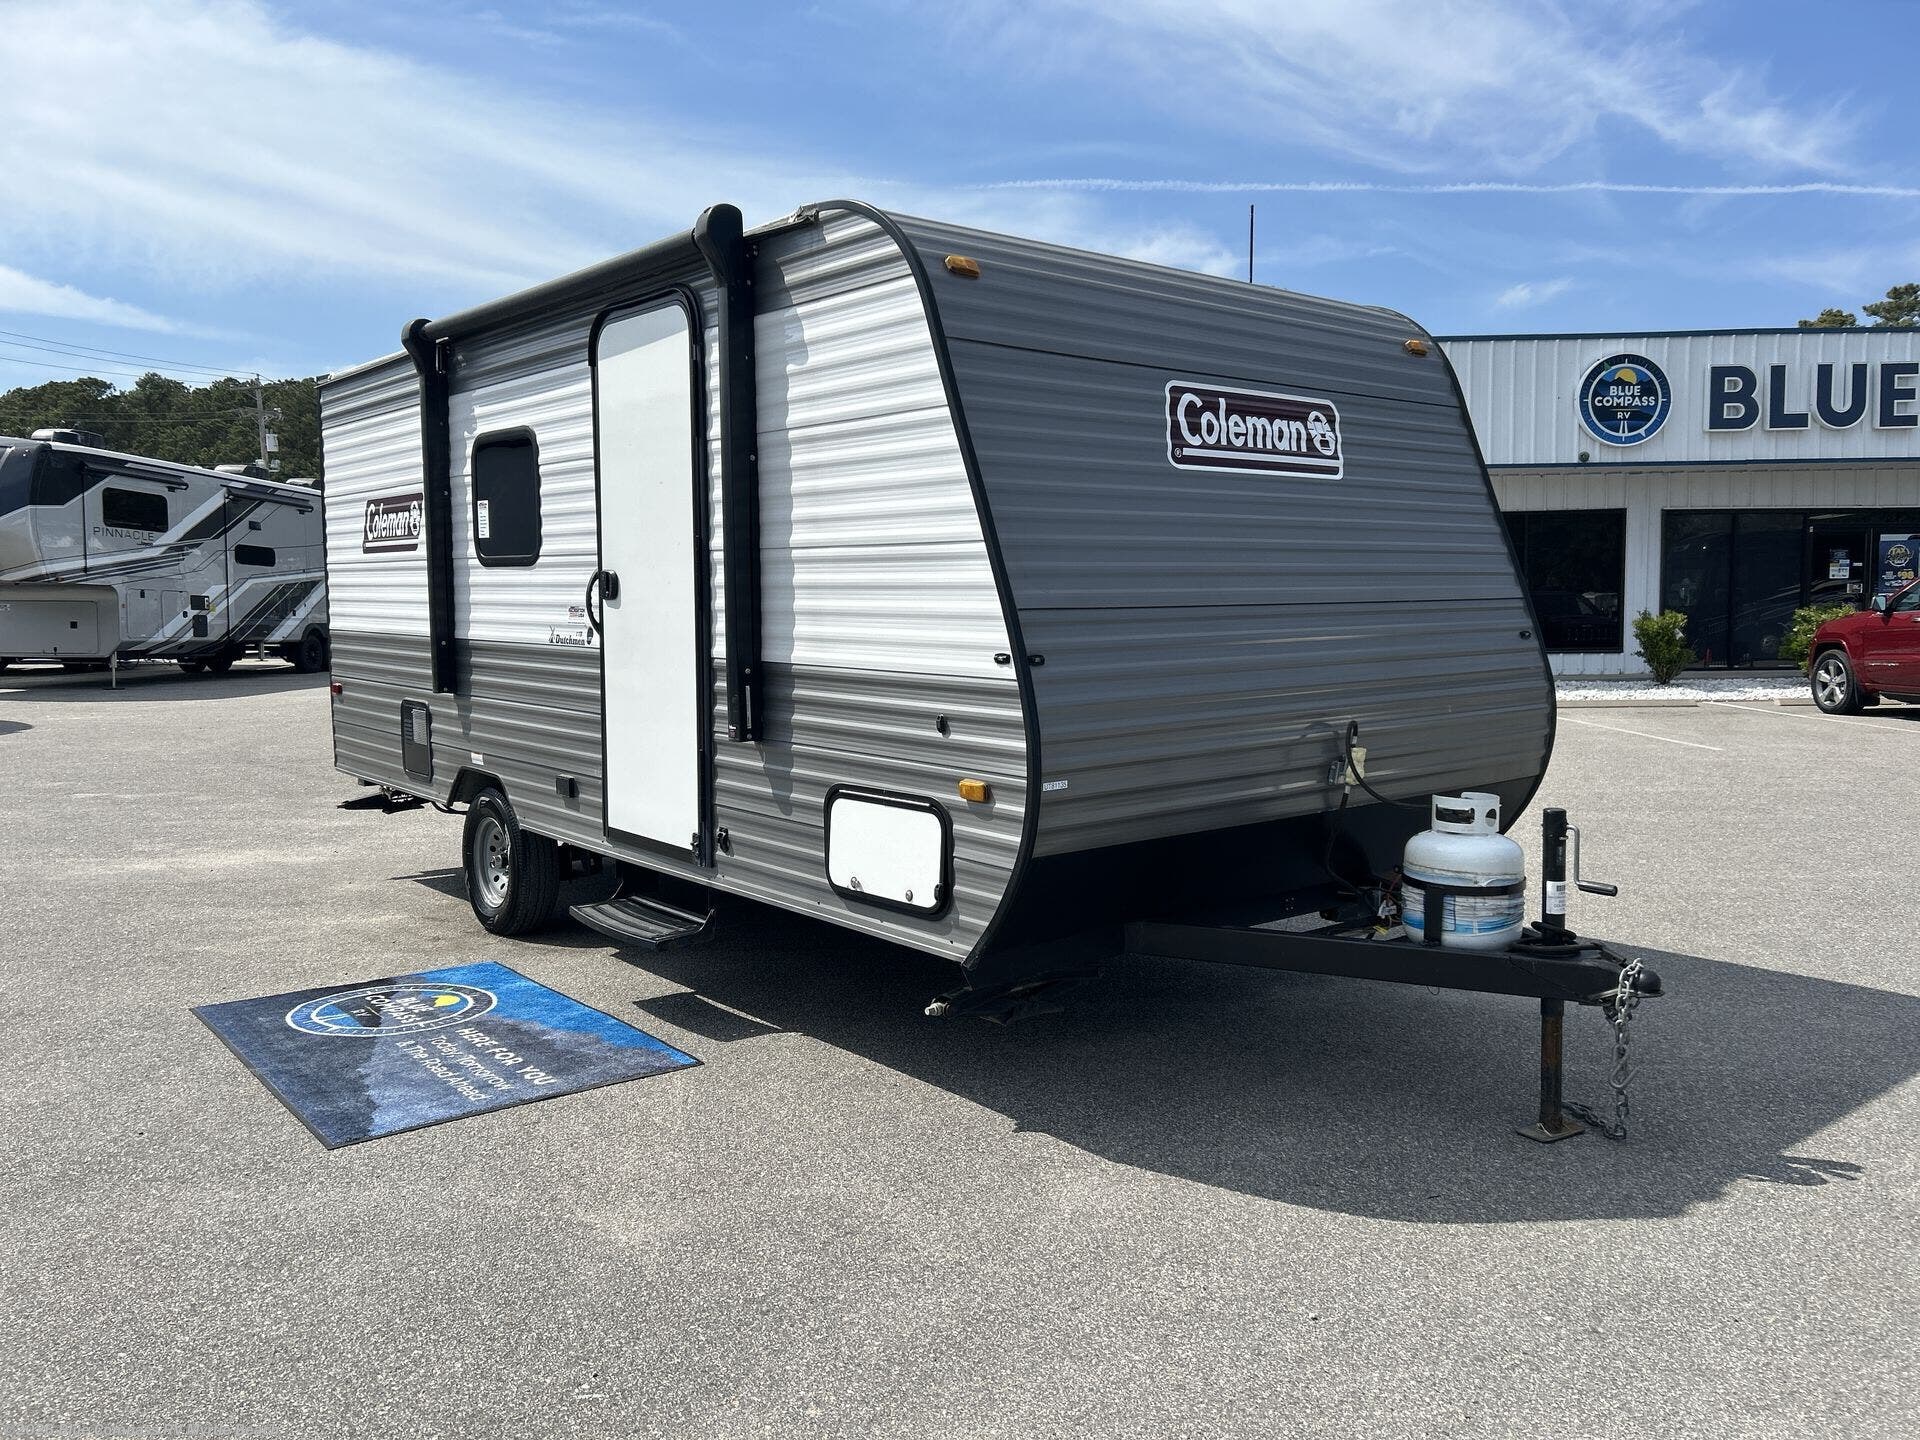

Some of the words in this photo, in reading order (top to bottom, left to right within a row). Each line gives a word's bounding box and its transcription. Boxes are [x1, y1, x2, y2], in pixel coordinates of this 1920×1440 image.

[1609, 385, 1641, 396] BLUE
[1708, 362, 1919, 430] BLUE
[1594, 396, 1656, 407] COMPASS
[1177, 393, 1307, 452] Coleman
[1617, 411, 1631, 420] RV
[367, 503, 410, 541] Coleman
[93, 526, 154, 541] PINNACLE
[555, 634, 586, 646] Dutchmen
[364, 994, 422, 1024] COMPASS
[395, 996, 435, 1013] BLUE
[396, 1040, 416, 1048] &
[404, 1044, 429, 1060] The
[429, 1034, 463, 1058] Today,
[457, 1054, 514, 1091] Tomorrow
[455, 1027, 499, 1048] HERE
[485, 1047, 523, 1067] FOR
[515, 1065, 557, 1086] YOU
[419, 1057, 458, 1079] Road
[444, 1076, 491, 1102] Ahead
